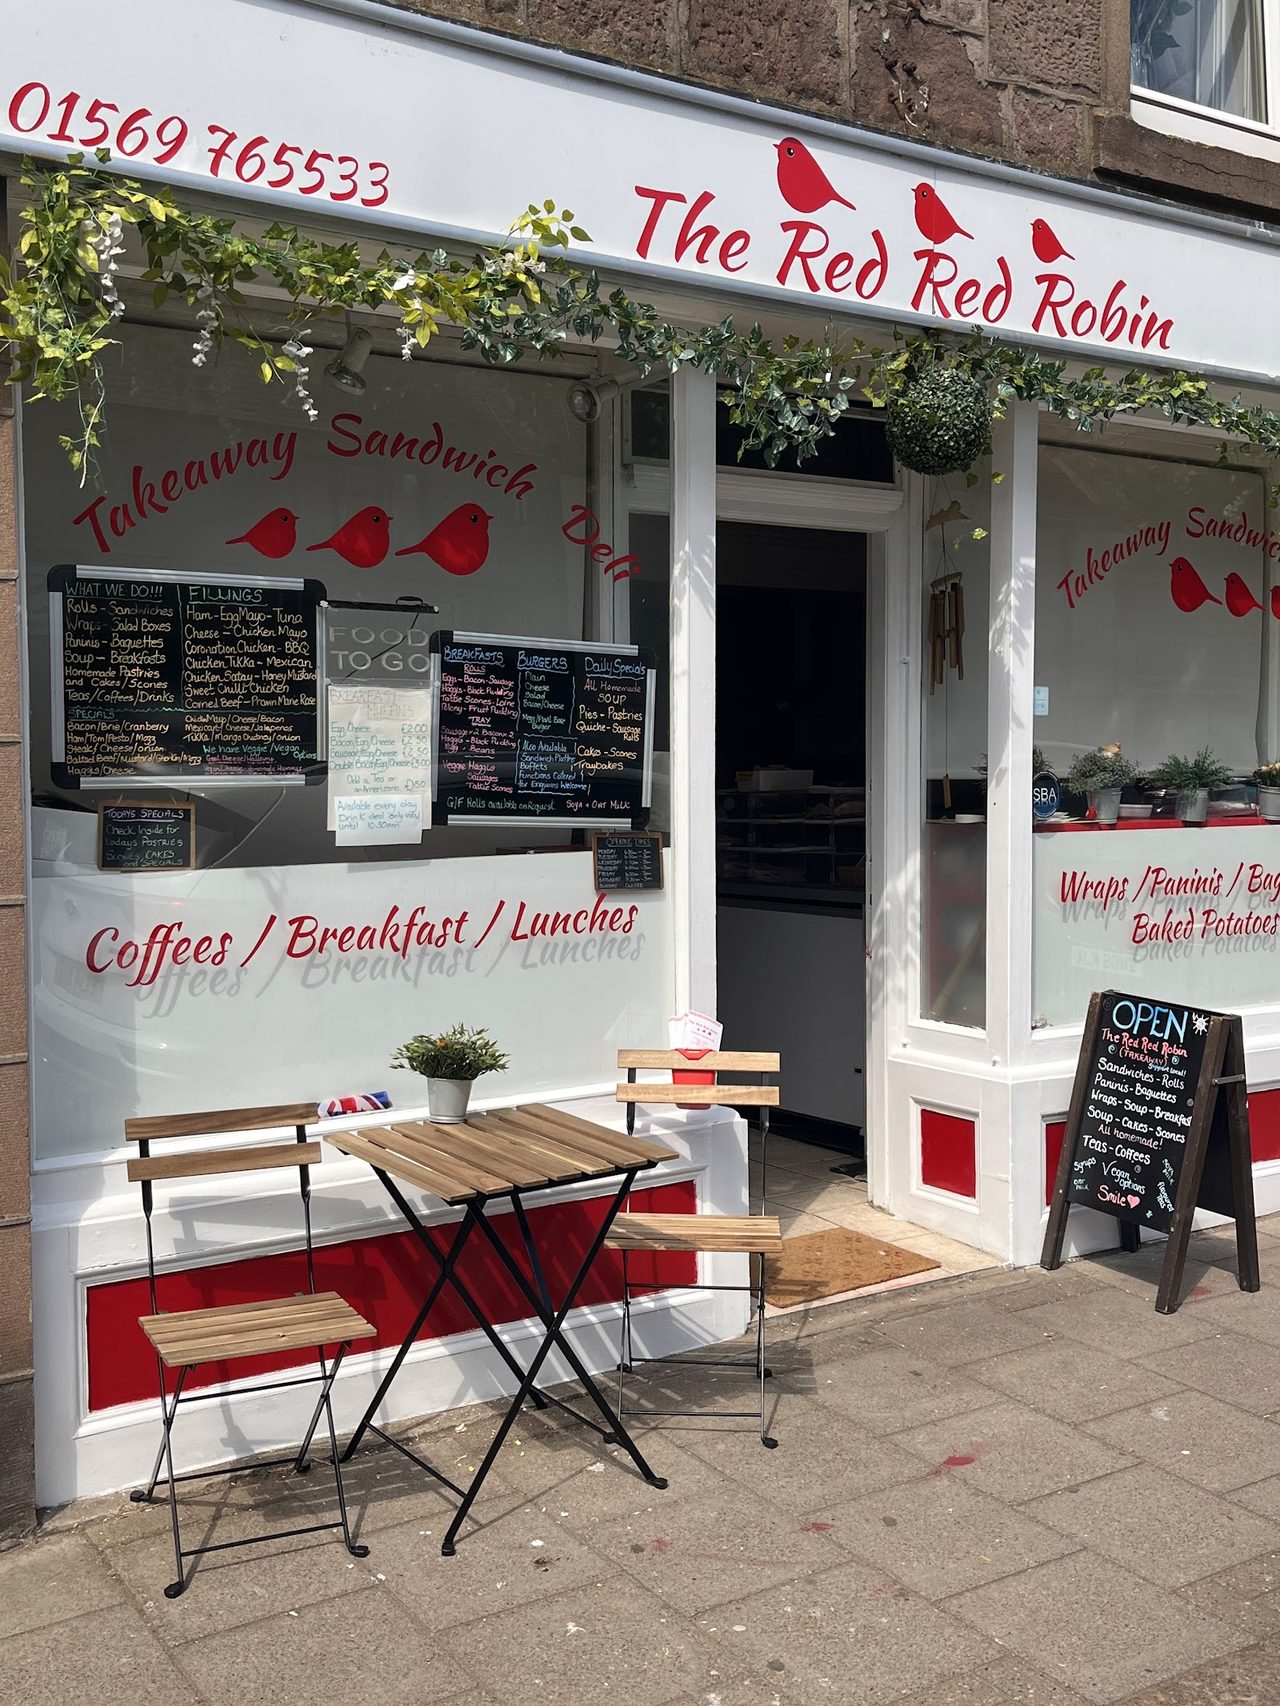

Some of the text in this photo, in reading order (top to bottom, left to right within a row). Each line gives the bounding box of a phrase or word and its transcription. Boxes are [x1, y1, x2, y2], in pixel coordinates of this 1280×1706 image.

[9, 81, 390, 207] 01569 765533
[635, 184, 1175, 350] The Red Red Robin
[72, 430, 296, 554] Takeaway
[326, 412, 538, 500] Sandwich
[1057, 506, 1280, 609] Takeaway Sandwic
[65, 581, 163, 598] WHAT WE DO!!!
[189, 586, 263, 603] FILLINGS
[67, 599, 174, 617] Rolls Sandwiches
[272, 607, 303, 624] Tuna
[111, 617, 138, 632] Salad
[141, 618, 171, 631] Boxes
[185, 624, 307, 641] Cheese Chicken Mayo
[65, 631, 164, 654] Paninis Baguettes
[329, 625, 429, 647] FOOD
[285, 641, 310, 655] BBQ
[444, 646, 504, 663] BREAKFASTS
[65, 650, 166, 669] Soup Breakfasts
[185, 656, 313, 670] Chicken Mexican
[330, 651, 430, 671] TO GO
[584, 656, 646, 677] Daily Specials
[65, 665, 160, 678] Homemade Pastries
[65, 678, 83, 686] and
[524, 681, 550, 692] Cheese
[600, 680, 641, 692] Homemade
[463, 695, 492, 706] Scones
[69, 710, 115, 719] SPECIALS
[579, 704, 643, 721] Pies Pastries
[575, 721, 606, 734] Quiche
[218, 745, 240, 753] have
[470, 745, 496, 755] Beans
[537, 740, 567, 753] Available
[610, 747, 638, 760] Scones
[520, 752, 554, 763] Sandwich
[573, 760, 624, 776] Traybakes
[491, 784, 513, 794] Scones
[560, 781, 588, 791] Welcome
[1033, 787, 1057, 801] SBA
[466, 797, 486, 809] Rolls
[104, 808, 184, 819] TODAYS SPECIALS
[106, 824, 136, 836] Check
[166, 824, 180, 834] for
[140, 858, 184, 867] SPECIALS
[145, 850, 175, 859] CAKES
[1060, 870, 1129, 911] Wraps
[1132, 907, 1280, 944] Baked Potatoes
[85, 921, 234, 987] Coffees
[286, 904, 469, 959] Breakfast
[510, 891, 639, 940] Lunches
[1112, 1000, 1189, 1043] OPEN
[1101, 1027, 1188, 1058] The Red Red Robin
[1097, 1057, 1185, 1090] Sandwiches Rolls
[1094, 1072, 1177, 1103] Paninis Baguettes
[1091, 1088, 1118, 1108] Wraps
[1124, 1098, 1148, 1115] Soup
[1087, 1105, 1186, 1144] Soup Cakes Scones
[1082, 1135, 1151, 1165] Teas Coffees
[1102, 1161, 1131, 1182] Vegan
[1119, 1178, 1146, 1195] options
[1097, 1184, 1126, 1207] Smile
